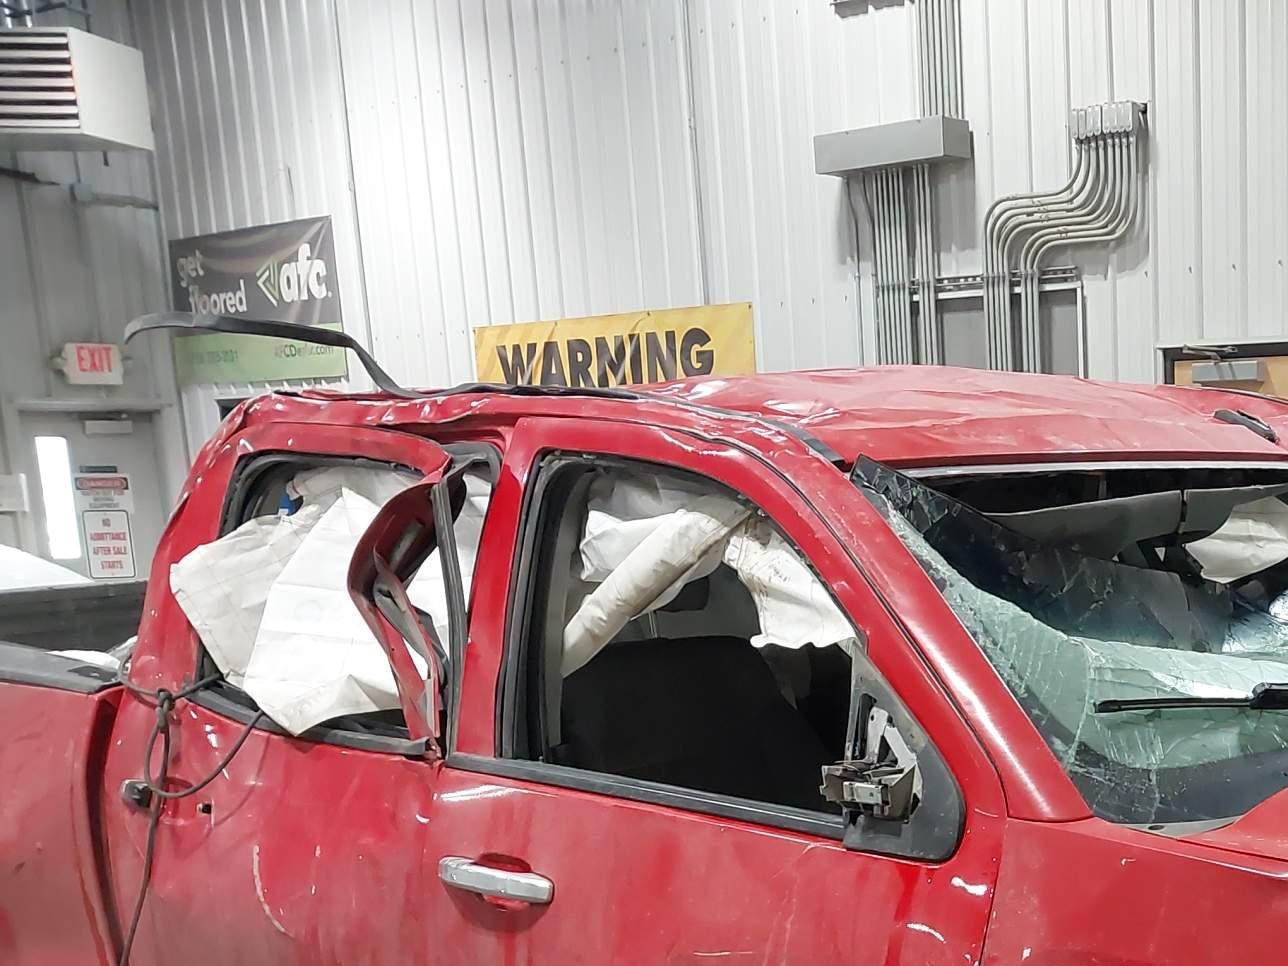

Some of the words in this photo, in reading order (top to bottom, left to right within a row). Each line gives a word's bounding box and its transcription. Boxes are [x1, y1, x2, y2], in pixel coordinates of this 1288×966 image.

[175, 250, 205, 288] get
[76, 345, 113, 374] EXIT
[496, 327, 714, 388] WARNING
[93, 546, 112, 556] AFTER
[112, 546, 128, 556] SALE
